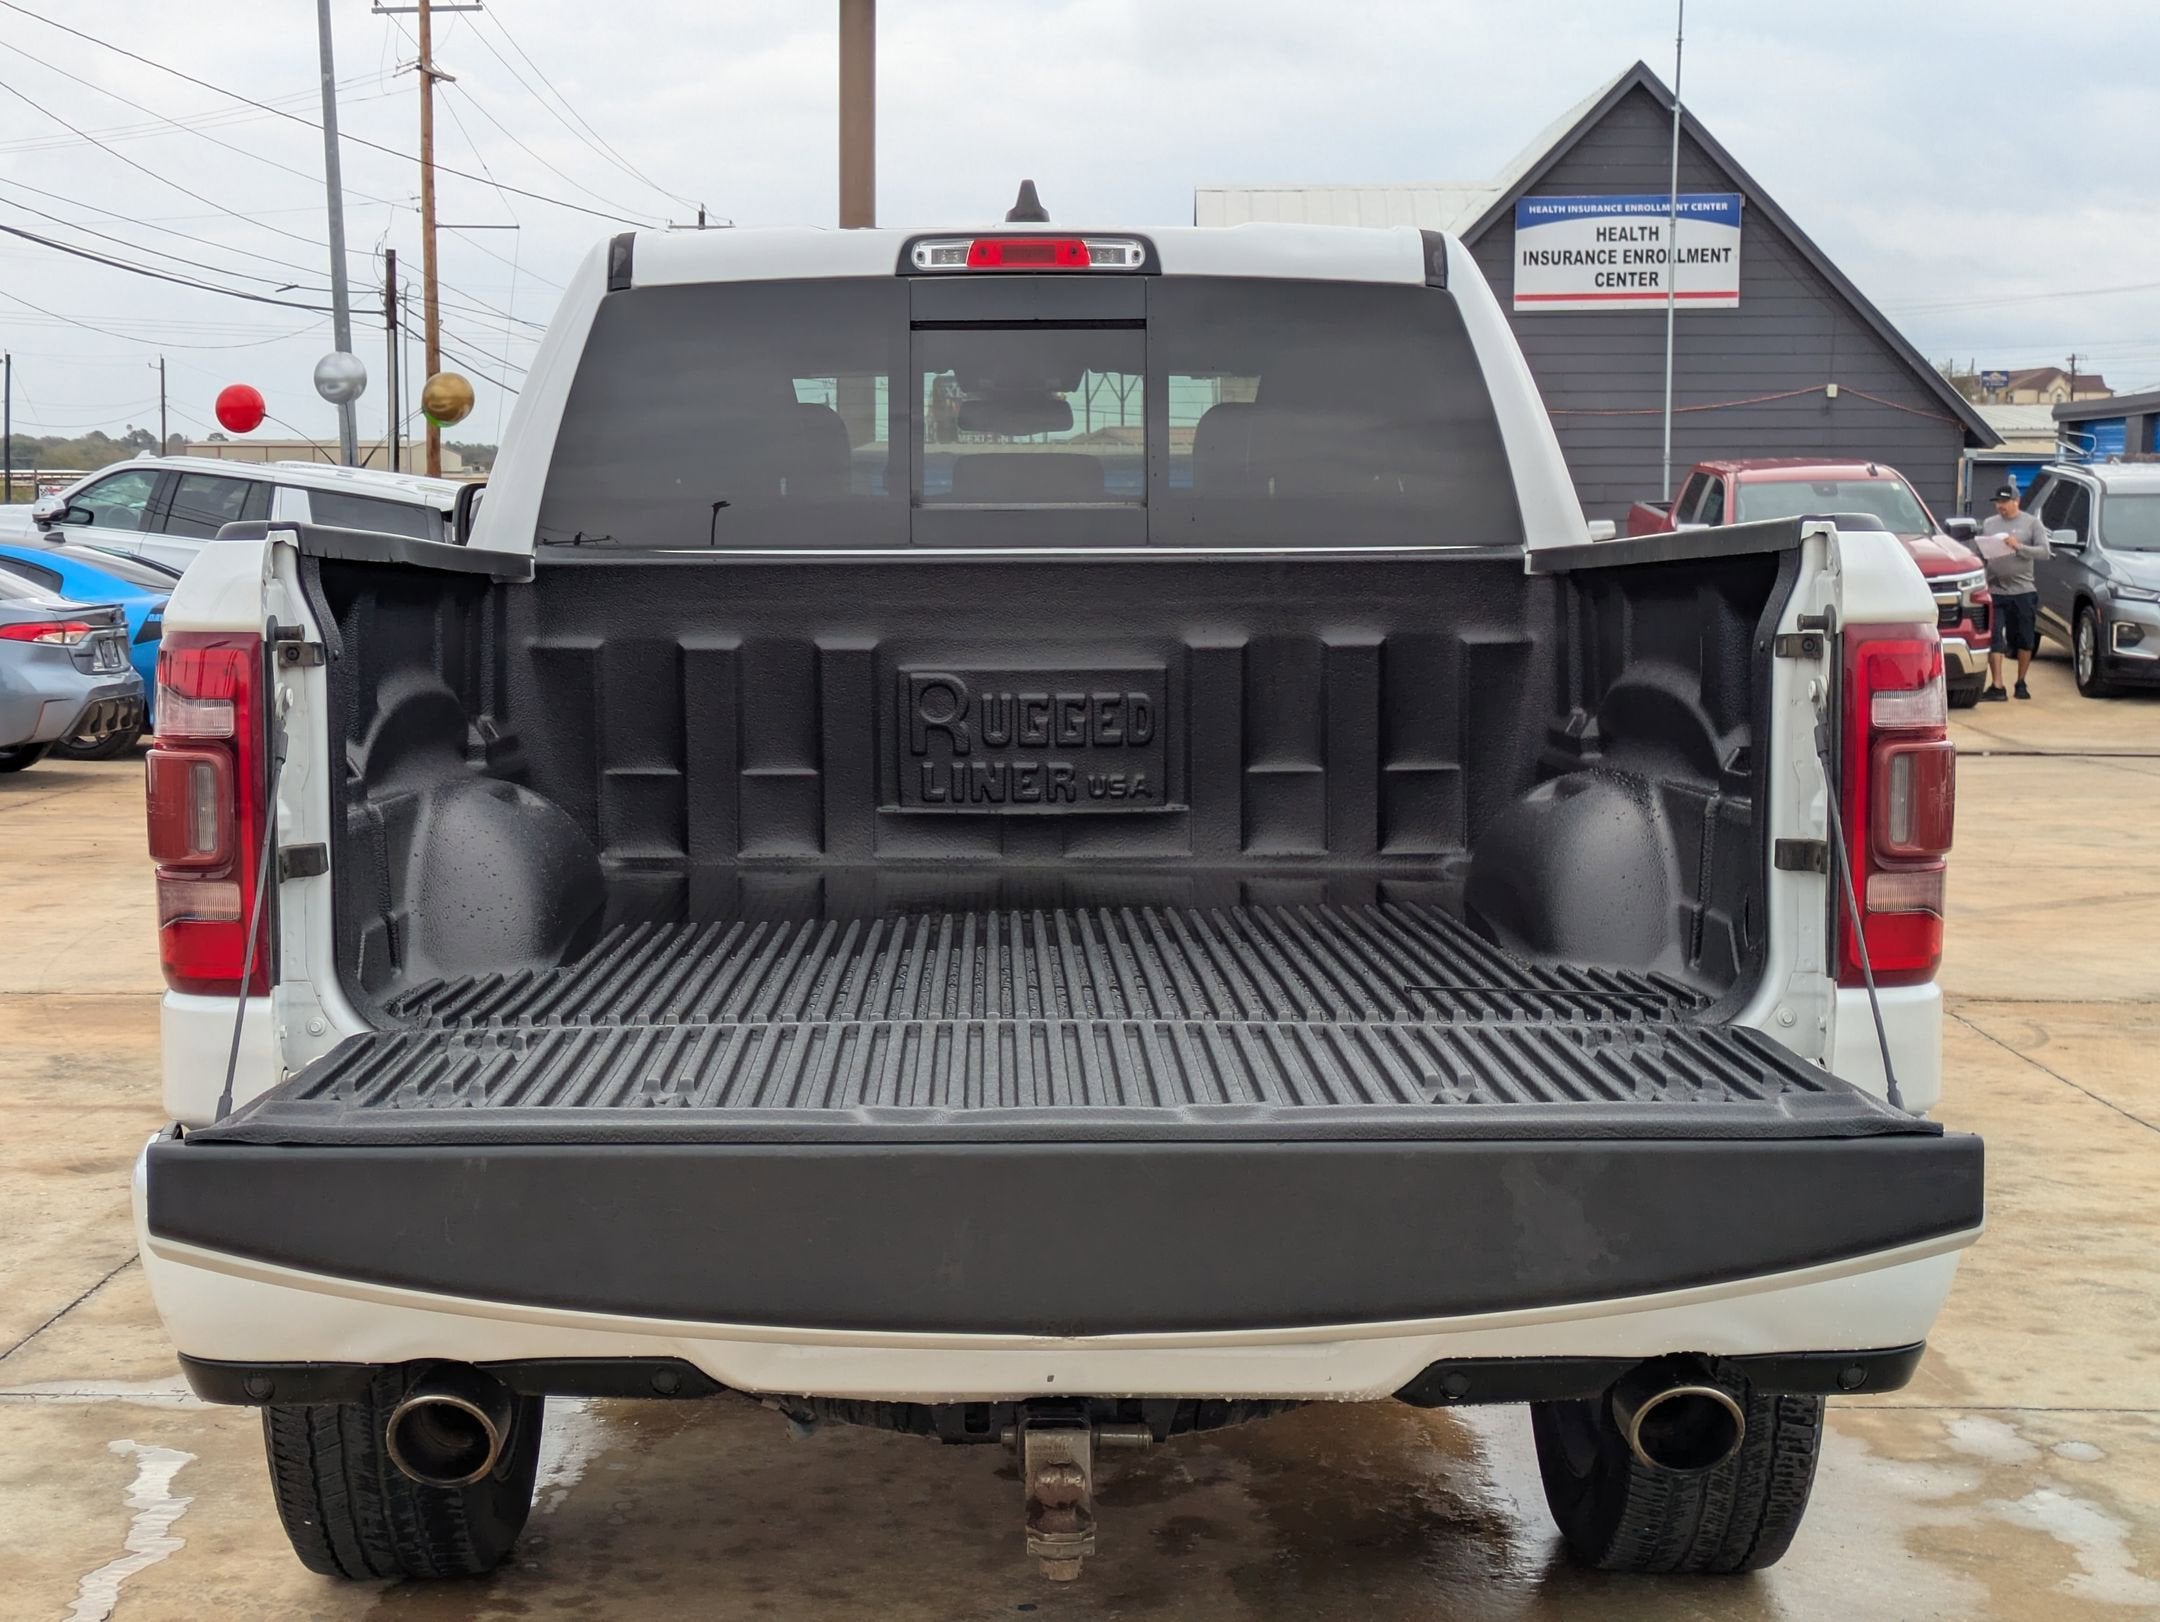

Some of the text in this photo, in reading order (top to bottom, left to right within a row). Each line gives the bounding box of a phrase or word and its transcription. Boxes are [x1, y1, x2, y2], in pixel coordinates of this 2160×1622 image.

[1528, 202, 1728, 215] HEALTH INSURANCE ENROLLMNT CENTER
[1596, 226, 1660, 242] HEALTH
[1523, 247, 1732, 266] INSURANCE ENROLLMENT
[1594, 271, 1659, 288] CENTER
[910, 672, 1155, 756] RUGGED
[921, 762, 1152, 804] LINER USA
